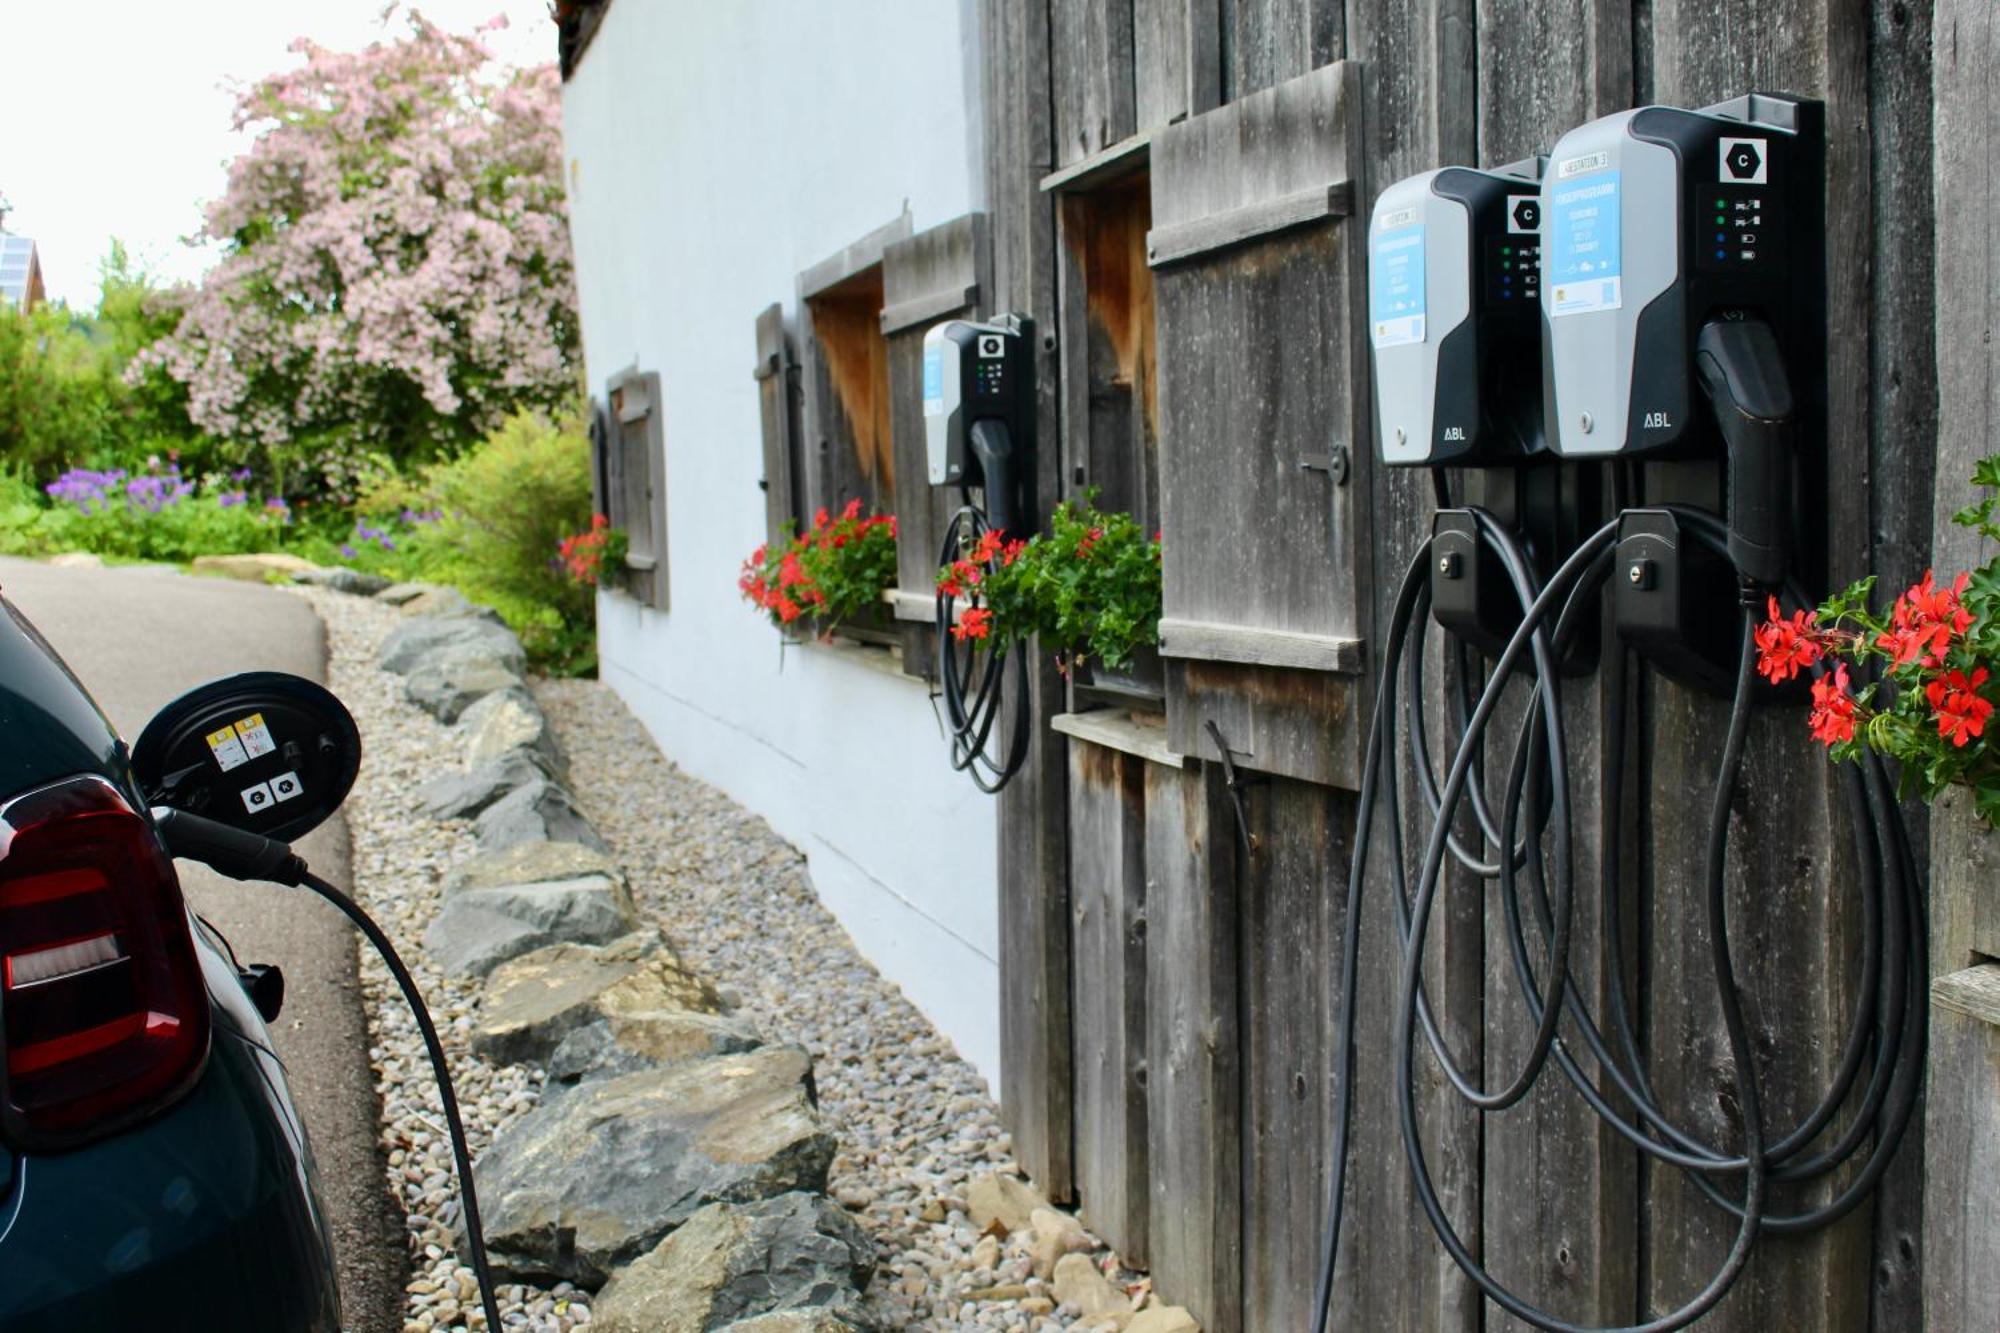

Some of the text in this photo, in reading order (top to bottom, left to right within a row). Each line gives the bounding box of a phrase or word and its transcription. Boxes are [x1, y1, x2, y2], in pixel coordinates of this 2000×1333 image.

[1738, 154, 1748, 167] C
[1524, 209, 1533, 220] C
[1644, 412, 1671, 428] ABL
[1444, 427, 1466, 440] ABL
